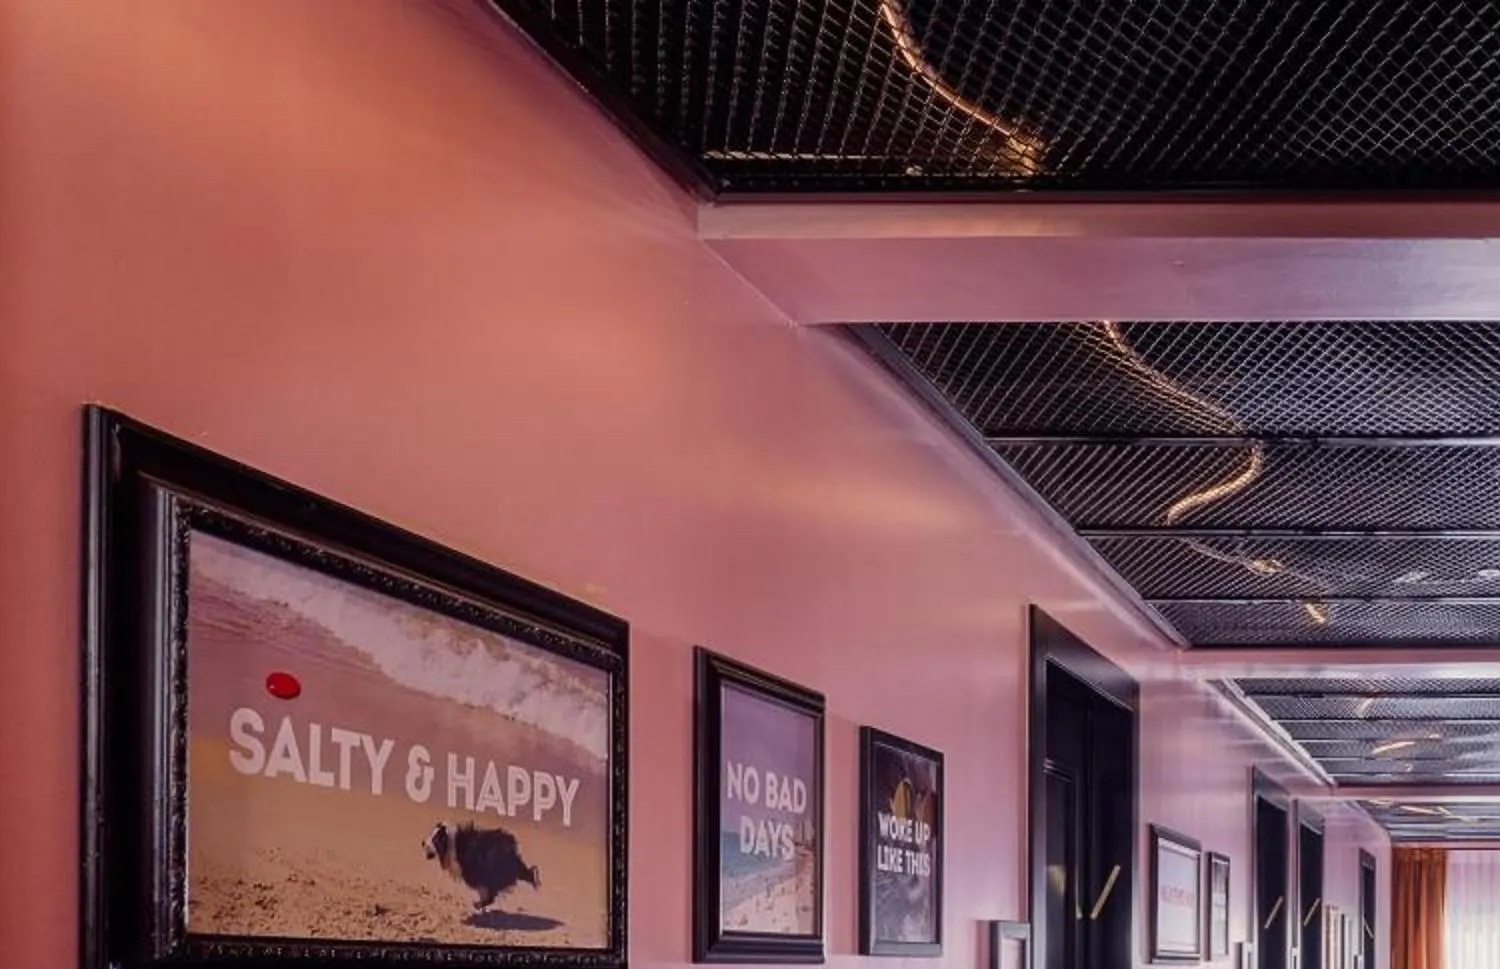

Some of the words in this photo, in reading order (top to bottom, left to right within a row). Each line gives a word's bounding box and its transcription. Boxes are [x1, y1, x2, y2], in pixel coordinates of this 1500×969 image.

[229, 707, 395, 796] SALTY
[406, 744, 434, 803] &
[447, 752, 581, 826] HAPPY
[726, 760, 761, 804] NO
[765, 770, 807, 815] BAD
[740, 815, 796, 861] DAYS
[877, 810, 913, 843] WOKE
[915, 820, 932, 845] UP
[877, 844, 903, 873] LIKE
[904, 848, 931, 877] THIS
